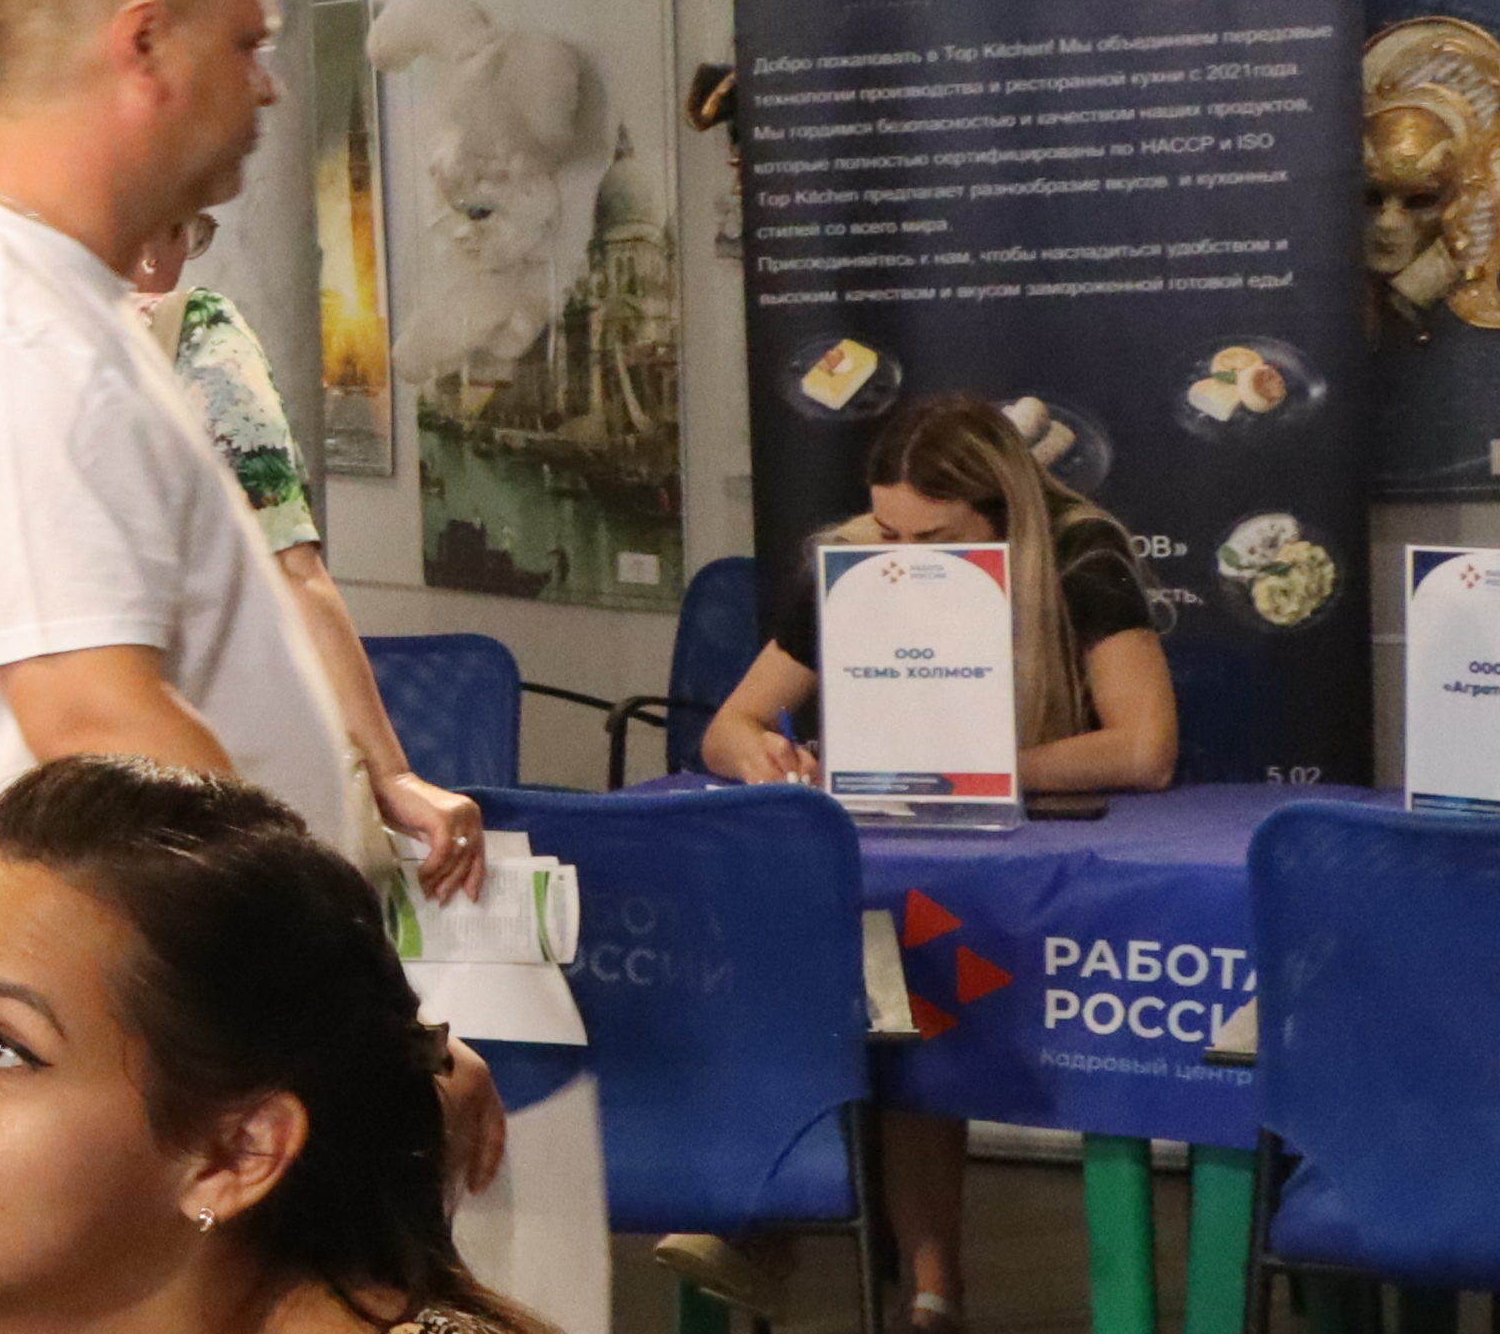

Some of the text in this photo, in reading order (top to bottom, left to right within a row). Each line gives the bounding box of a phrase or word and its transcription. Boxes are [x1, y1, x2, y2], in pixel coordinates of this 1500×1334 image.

[753, 57, 813, 75] Добро
[816, 52, 922, 68] пожаловать
[943, 45, 979, 64] Top
[1059, 38, 1092, 53] Мы
[1222, 25, 1334, 44] передовые
[754, 89, 856, 107] технологии
[860, 82, 984, 104] производства
[1005, 71, 1125, 95] ресторанной
[754, 126, 785, 140] Мы
[789, 121, 873, 140] гордимся
[877, 114, 1016, 134] безопасностью
[1037, 108, 1135, 127] качеством
[1139, 104, 1200, 119] наших
[754, 160, 830, 176] которые
[834, 155, 929, 170] полностью
[1110, 143, 1134, 156] по
[1220, 139, 1232, 151] и
[1237, 133, 1275, 151] ISO
[758, 192, 791, 209] Top
[795, 189, 859, 205] Kitchen
[863, 185, 964, 205] предлагает
[969, 178, 1100, 200] разнообразие
[1179, 175, 1192, 187] и
[1197, 170, 1289, 189] кухонных
[826, 223, 846, 236] со
[850, 221, 898, 235] всего
[758, 253, 915, 273] Присоединяйтесь
[979, 246, 1036, 262] чтобы
[1166, 238, 1270, 259] удобством
[1275, 239, 1288, 251] и
[845, 287, 936, 302] качеством
[939, 287, 952, 299] и
[956, 284, 1021, 302] вкусом
[1026, 276, 1164, 298] замороженной
[1168, 273, 1244, 290] готовой
[895, 648, 934, 660] ООО
[843, 667, 993, 679] "СЕМЬ ХОЛМОВ"
[1044, 936, 1258, 992] РАБОТ
[1044, 988, 1228, 1044] РОСС
[1040, 1048, 1254, 1087] Кадровый центр
